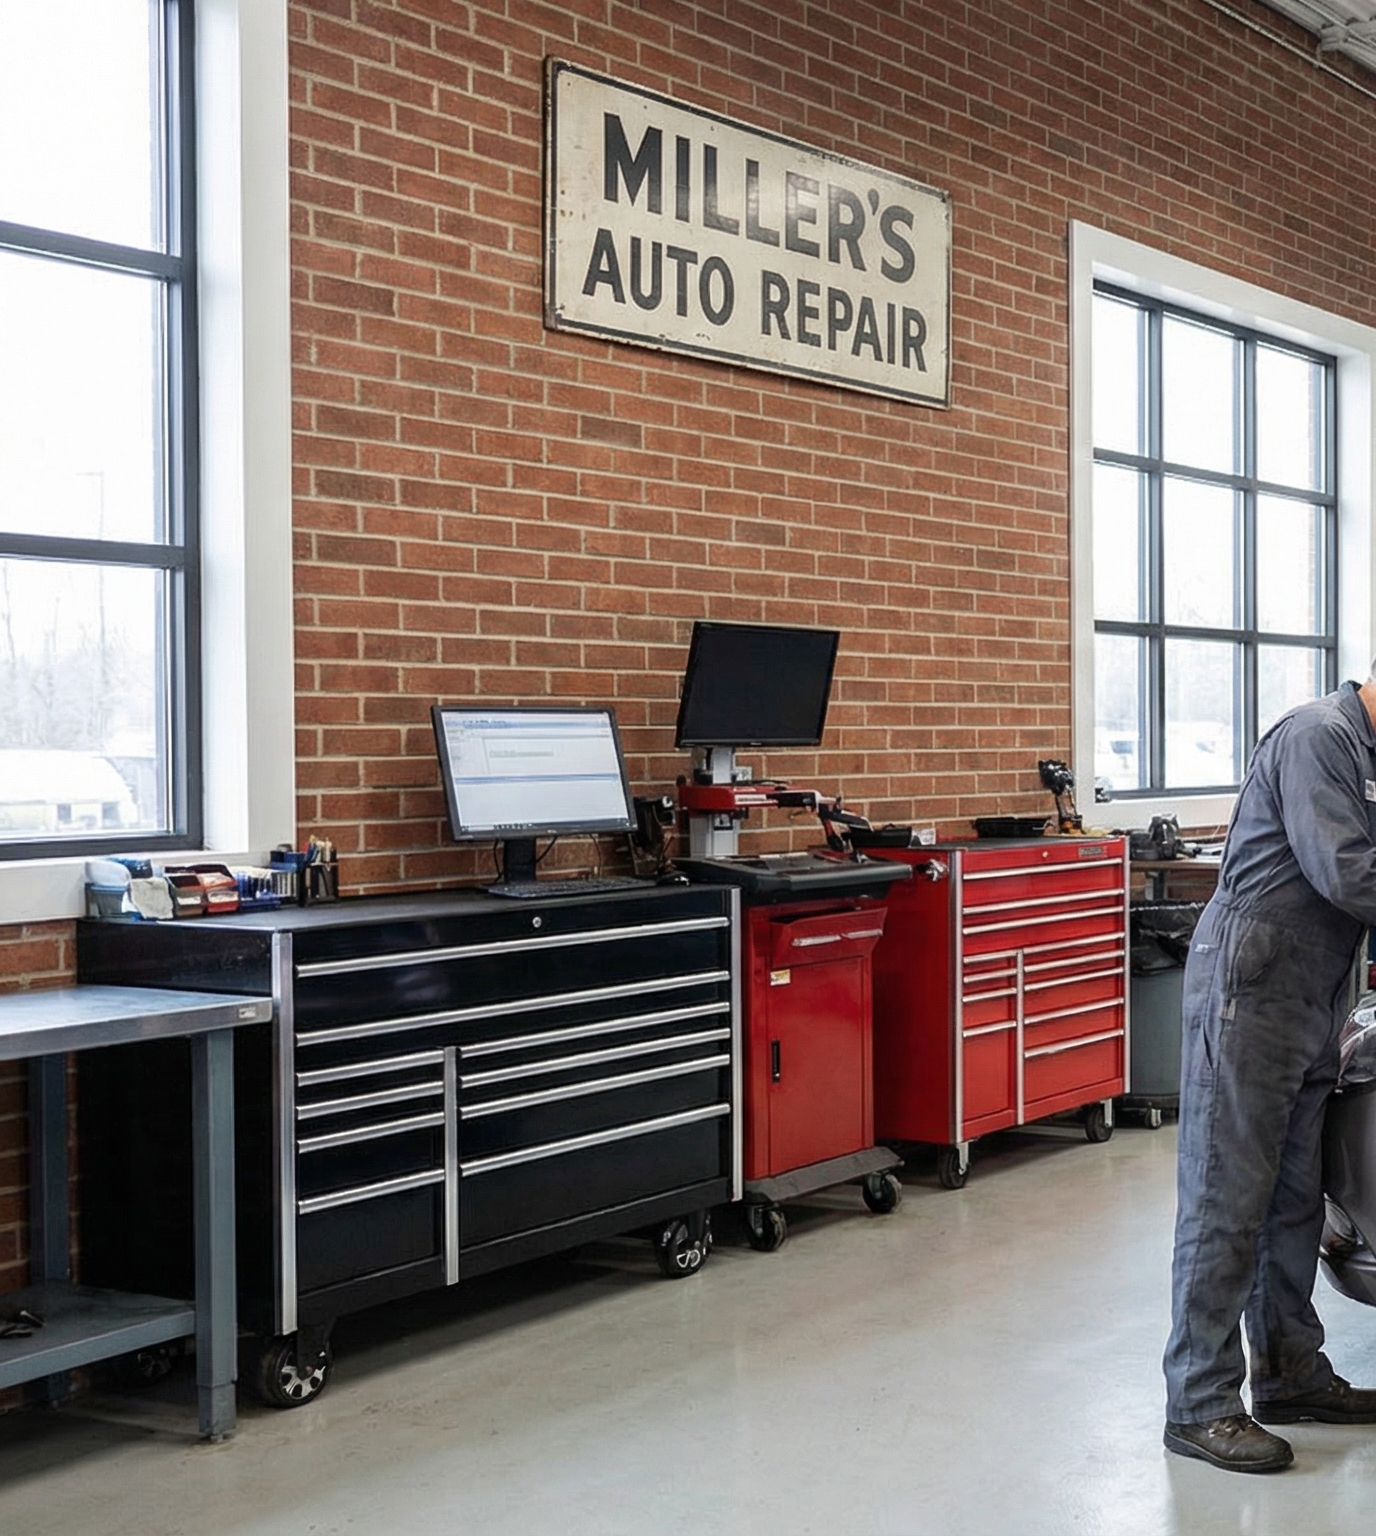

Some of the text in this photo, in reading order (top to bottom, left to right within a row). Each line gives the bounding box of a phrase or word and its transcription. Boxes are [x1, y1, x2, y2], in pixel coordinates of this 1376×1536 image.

[603, 112, 915, 283] MILLER'S
[582, 227, 928, 372] AUTO REPAIR
